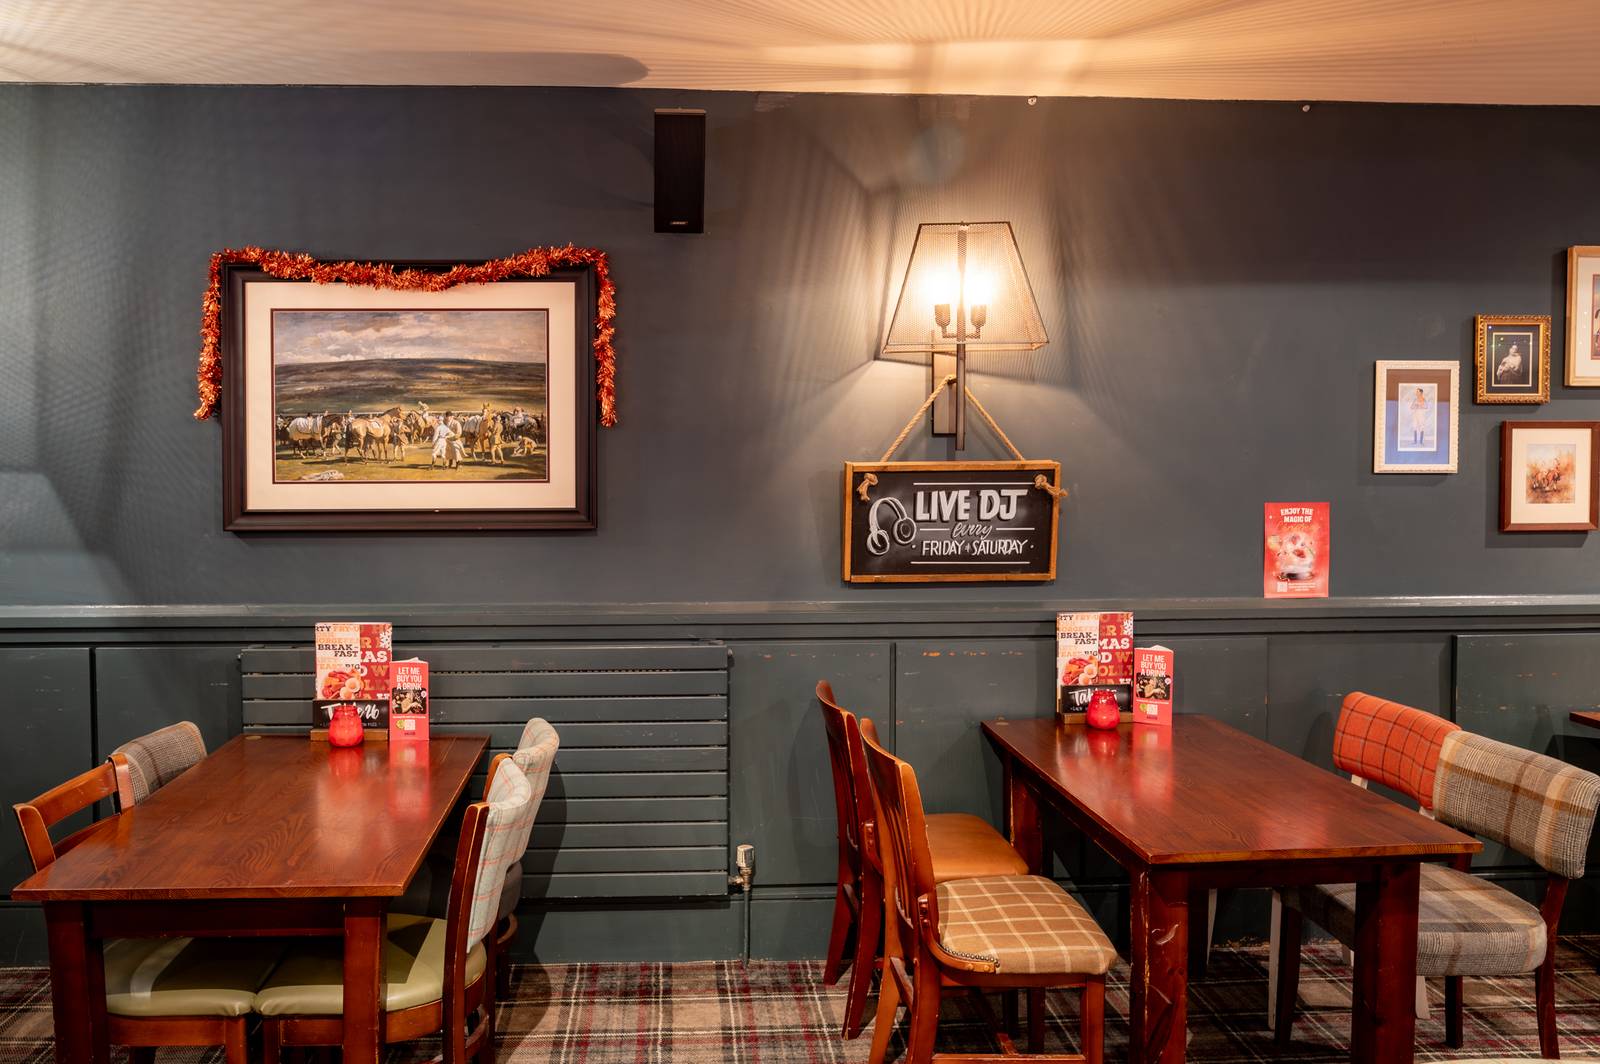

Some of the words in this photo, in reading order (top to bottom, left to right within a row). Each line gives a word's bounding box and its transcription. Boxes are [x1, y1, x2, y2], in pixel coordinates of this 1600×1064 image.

[916, 490, 970, 520] LIVE
[980, 489, 1028, 520] DJ
[952, 522, 993, 540] every
[922, 540, 965, 556] FRIDAY
[972, 540, 1028, 556] SATURDAY
